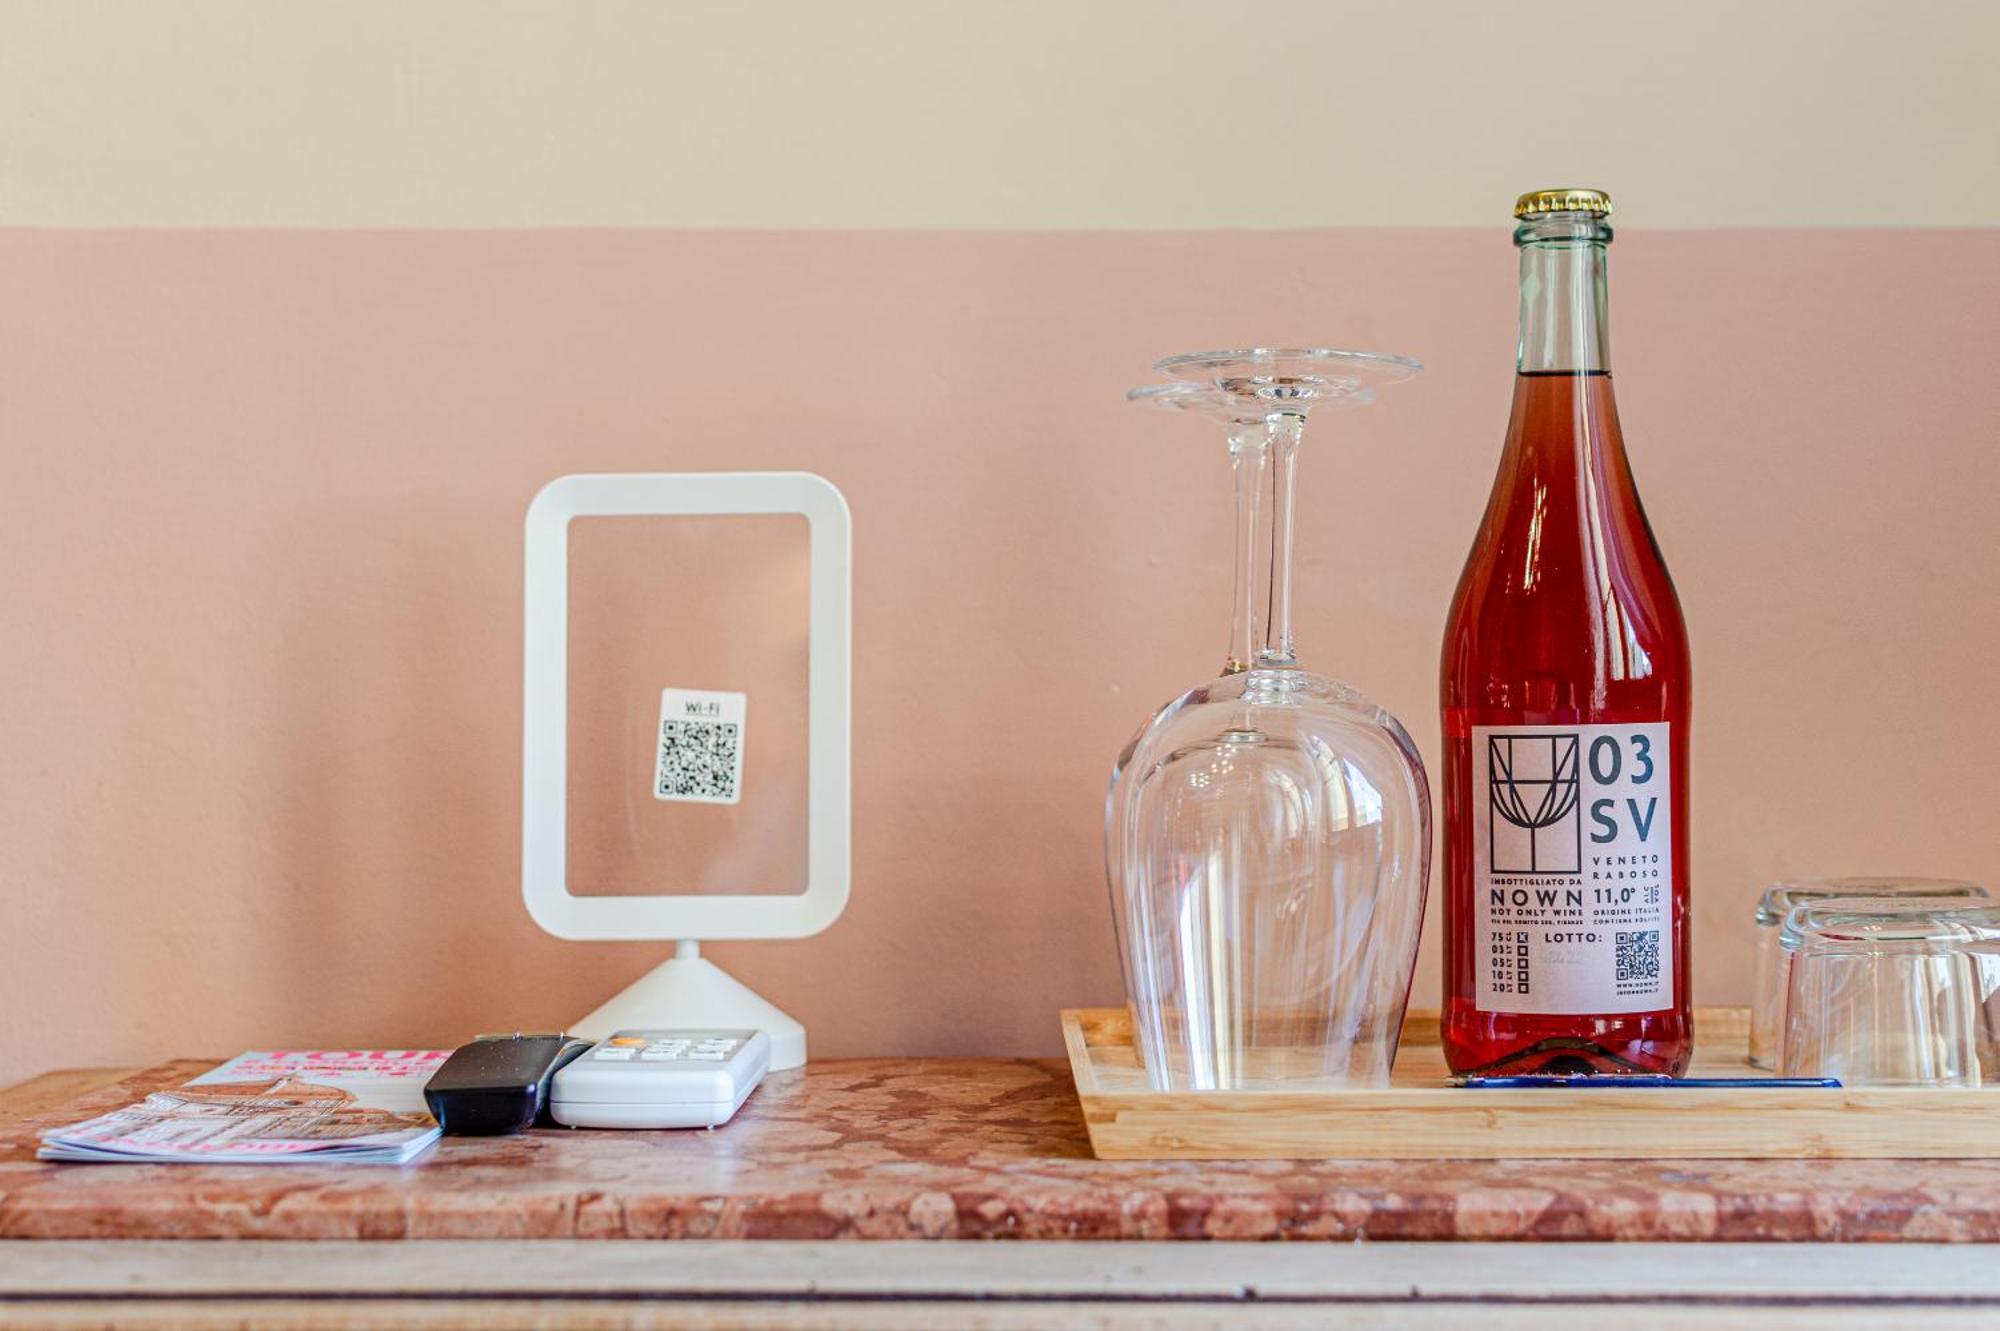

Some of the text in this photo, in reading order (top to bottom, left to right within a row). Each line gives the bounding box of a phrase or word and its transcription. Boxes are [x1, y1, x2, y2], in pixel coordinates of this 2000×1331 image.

[685, 700, 721, 714] Wi-Fi
[1589, 734, 1654, 786] 03
[1590, 797, 1658, 844] SV
[1592, 854, 1659, 866] VENETO
[1592, 869, 1659, 880] RABOSO
[1490, 878, 1582, 886] IMBOTTIGLIATO DA
[1490, 889, 1582, 907] NOWN
[1594, 887, 1636, 906] 11,0°
[1490, 908, 1583, 917] NOT ONLY WINE
[1592, 906, 1660, 916] ORIGINE ITALIA
[1491, 932, 1504, 942] 75
[1545, 933, 1603, 943] LOTTO:
[1492, 958, 1505, 968] 05
[1492, 970, 1504, 980] 10
[1492, 983, 1505, 992] 20
